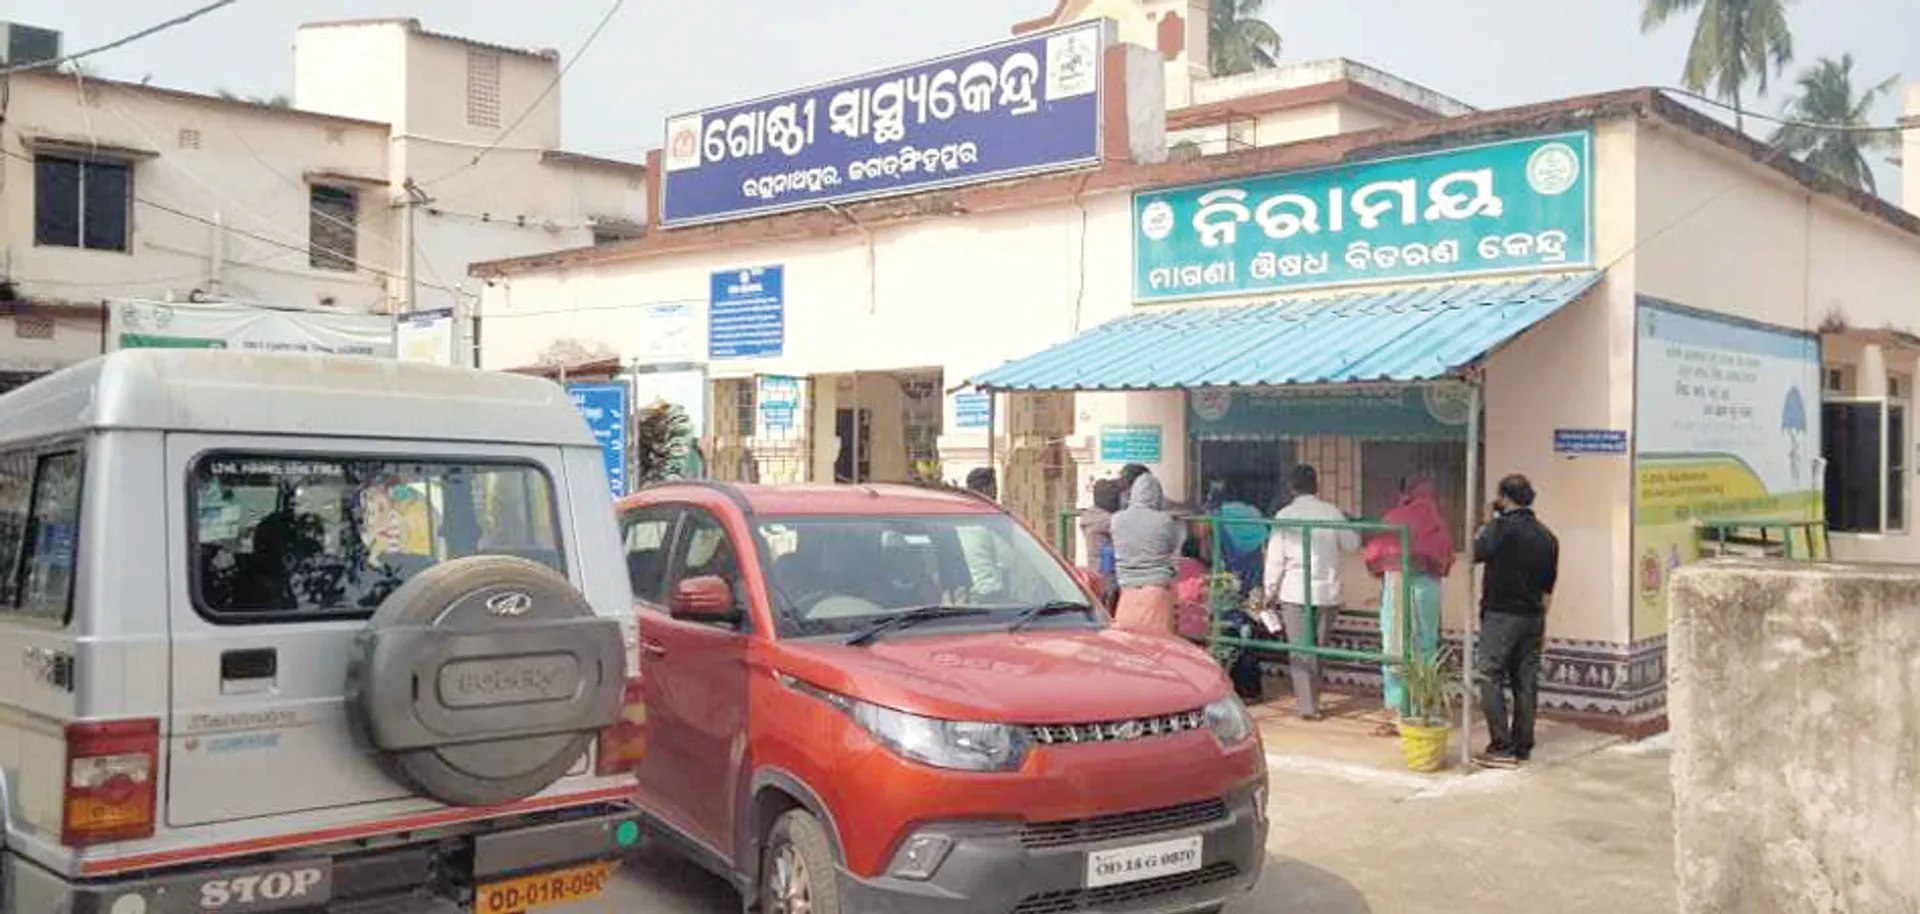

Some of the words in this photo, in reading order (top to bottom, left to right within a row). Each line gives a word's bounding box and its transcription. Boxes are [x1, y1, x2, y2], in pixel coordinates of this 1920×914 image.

[704, 98, 816, 162] ଗୋଷ୍ଠୀ
[1192, 167, 1503, 247] ନିରାମୟ
[1149, 260, 1235, 289] ମାଗଣା
[1250, 250, 1329, 279] ଔଷଧ
[1345, 239, 1460, 270] ବିତରଣ
[1477, 229, 1568, 262] କେନ୍ଦ୍ର
[200, 867, 322, 909] STOP
